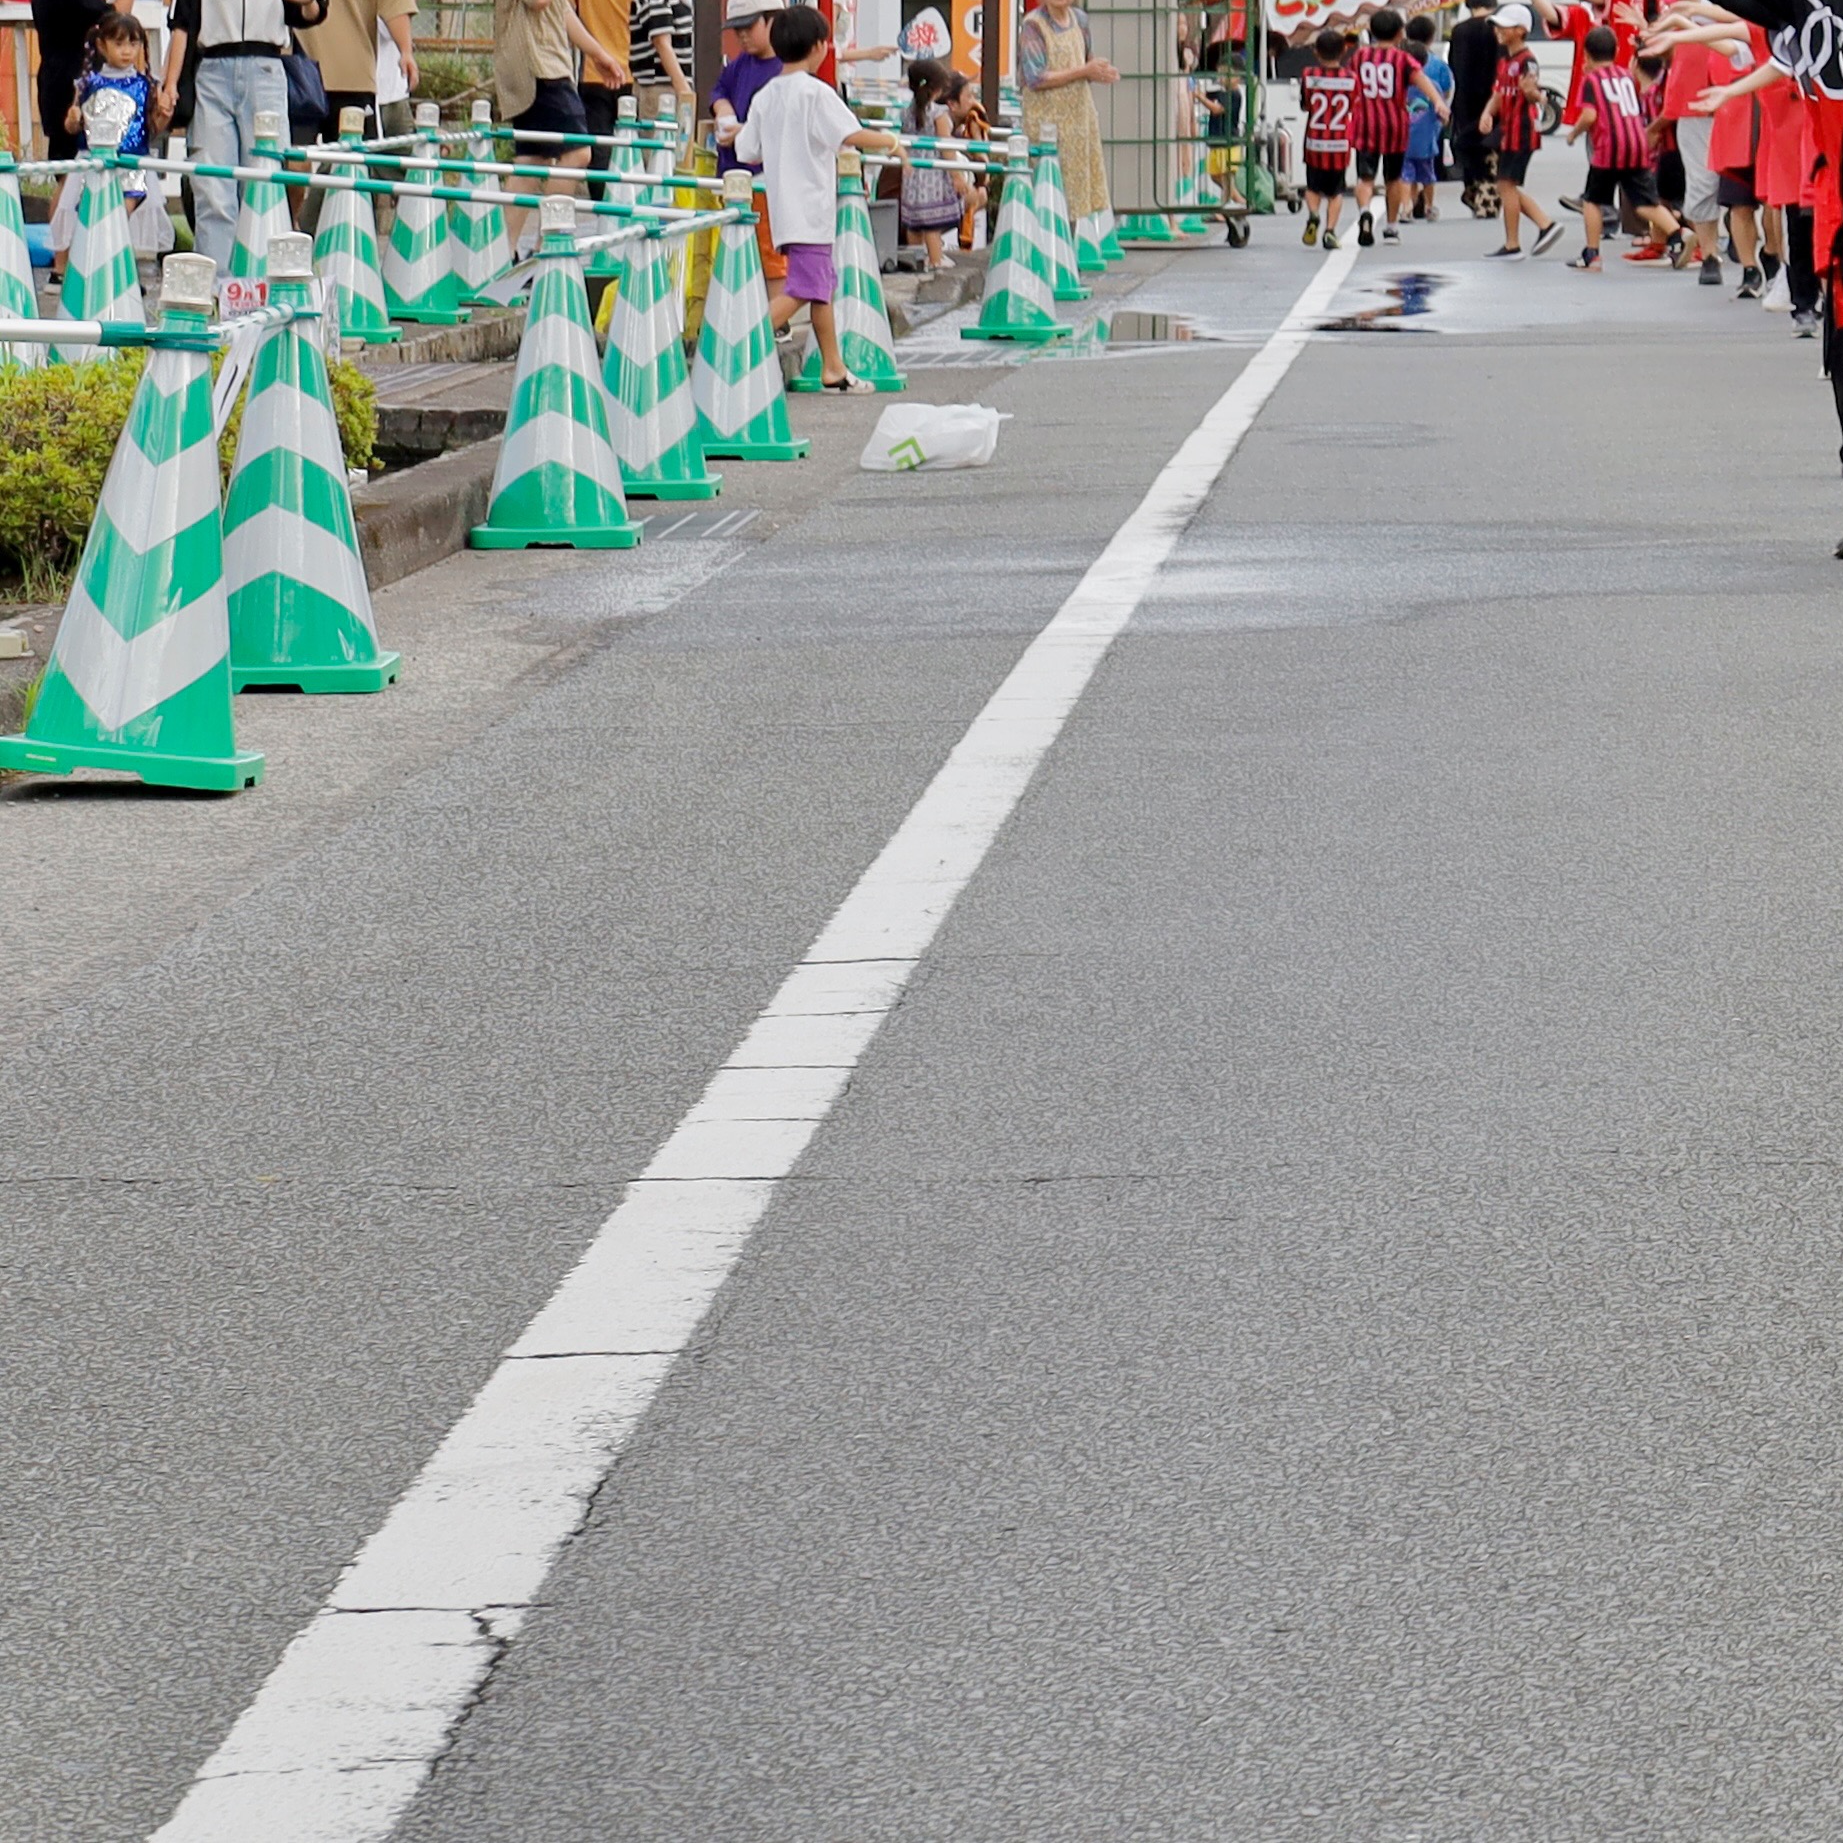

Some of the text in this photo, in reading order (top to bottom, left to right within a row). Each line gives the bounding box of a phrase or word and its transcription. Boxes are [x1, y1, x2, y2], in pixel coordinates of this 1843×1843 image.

[1360, 61, 1394, 99] 99
[1601, 76, 1640, 117] 40
[1310, 93, 1349, 131] 22
